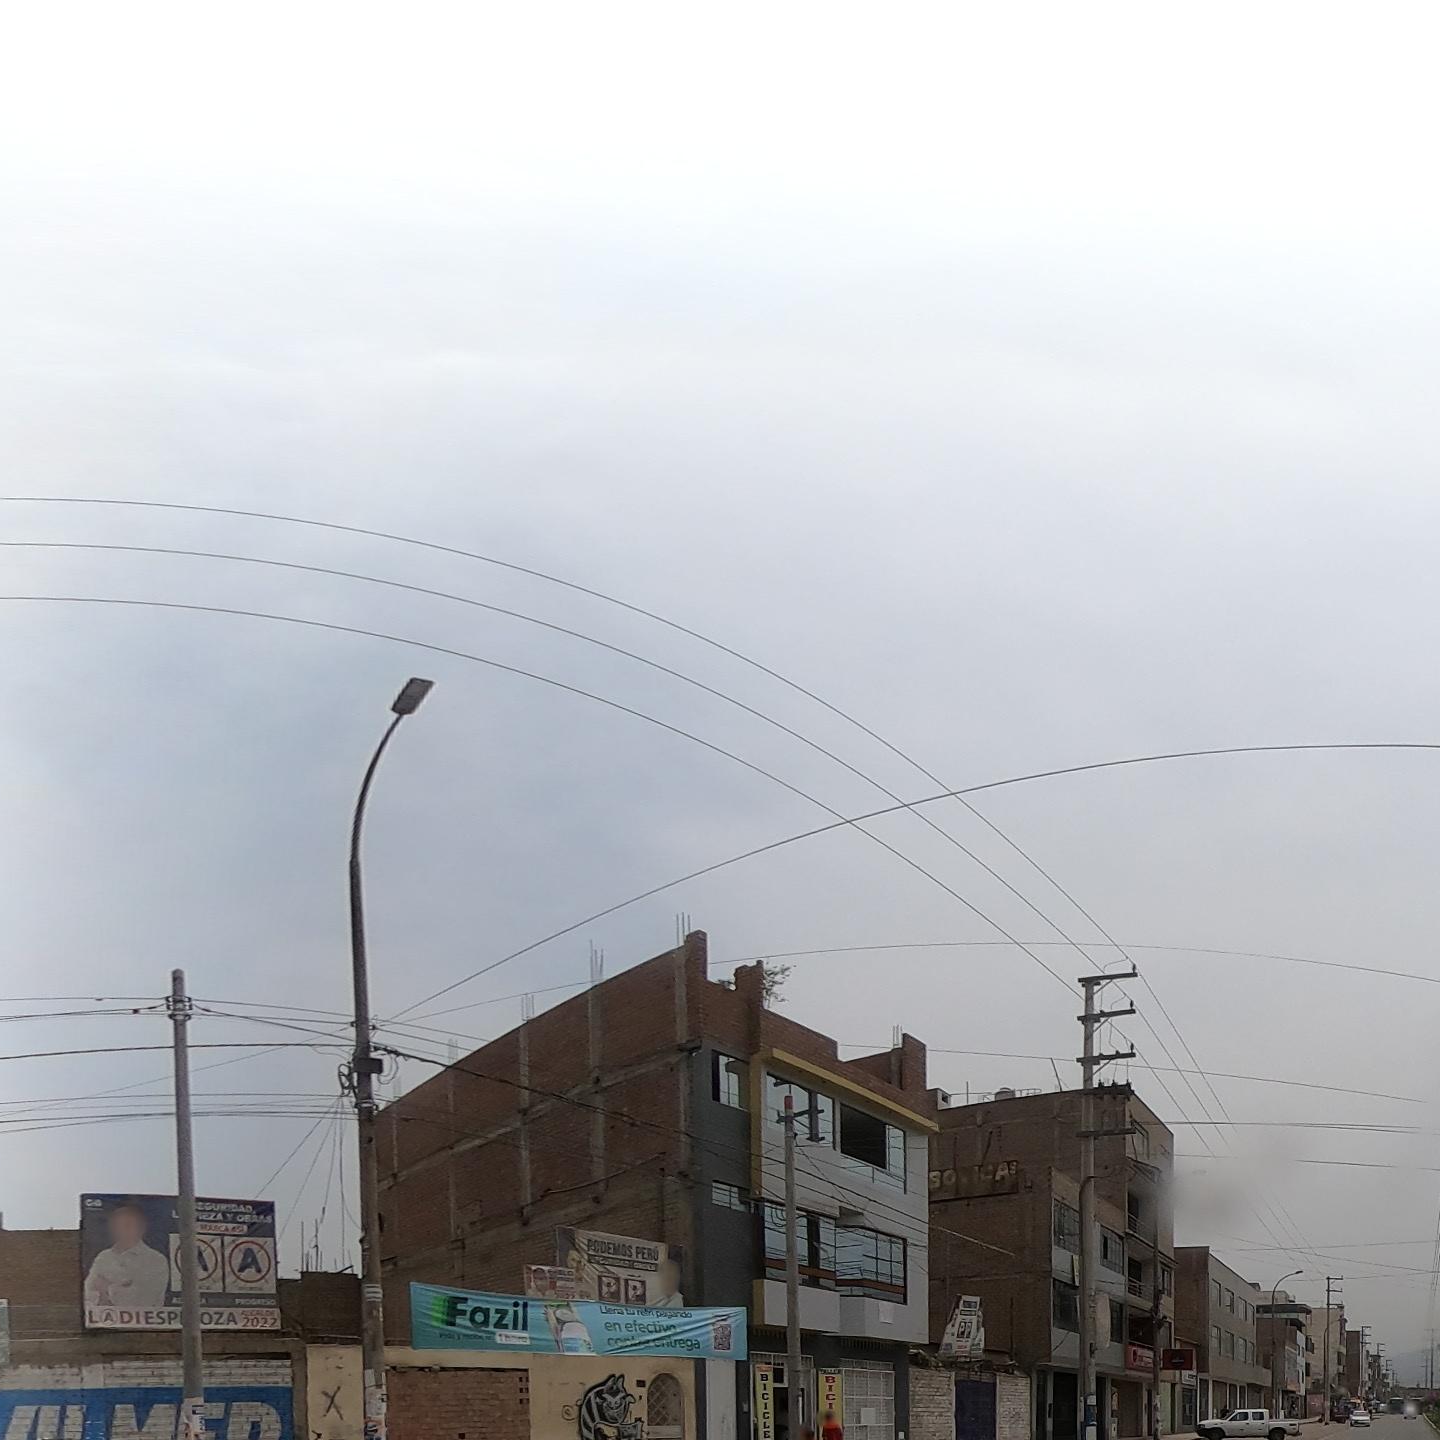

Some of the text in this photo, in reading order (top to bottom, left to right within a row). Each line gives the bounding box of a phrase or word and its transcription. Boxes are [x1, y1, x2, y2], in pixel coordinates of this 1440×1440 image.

[587, 1239, 633, 1258] PODEMOS
[145, 1310, 237, 1326] ESPIOZA
[446, 1296, 529, 1331] Fazil
[242, 1316, 278, 1328] 2022
[604, 1320, 677, 1333] en efectivo
